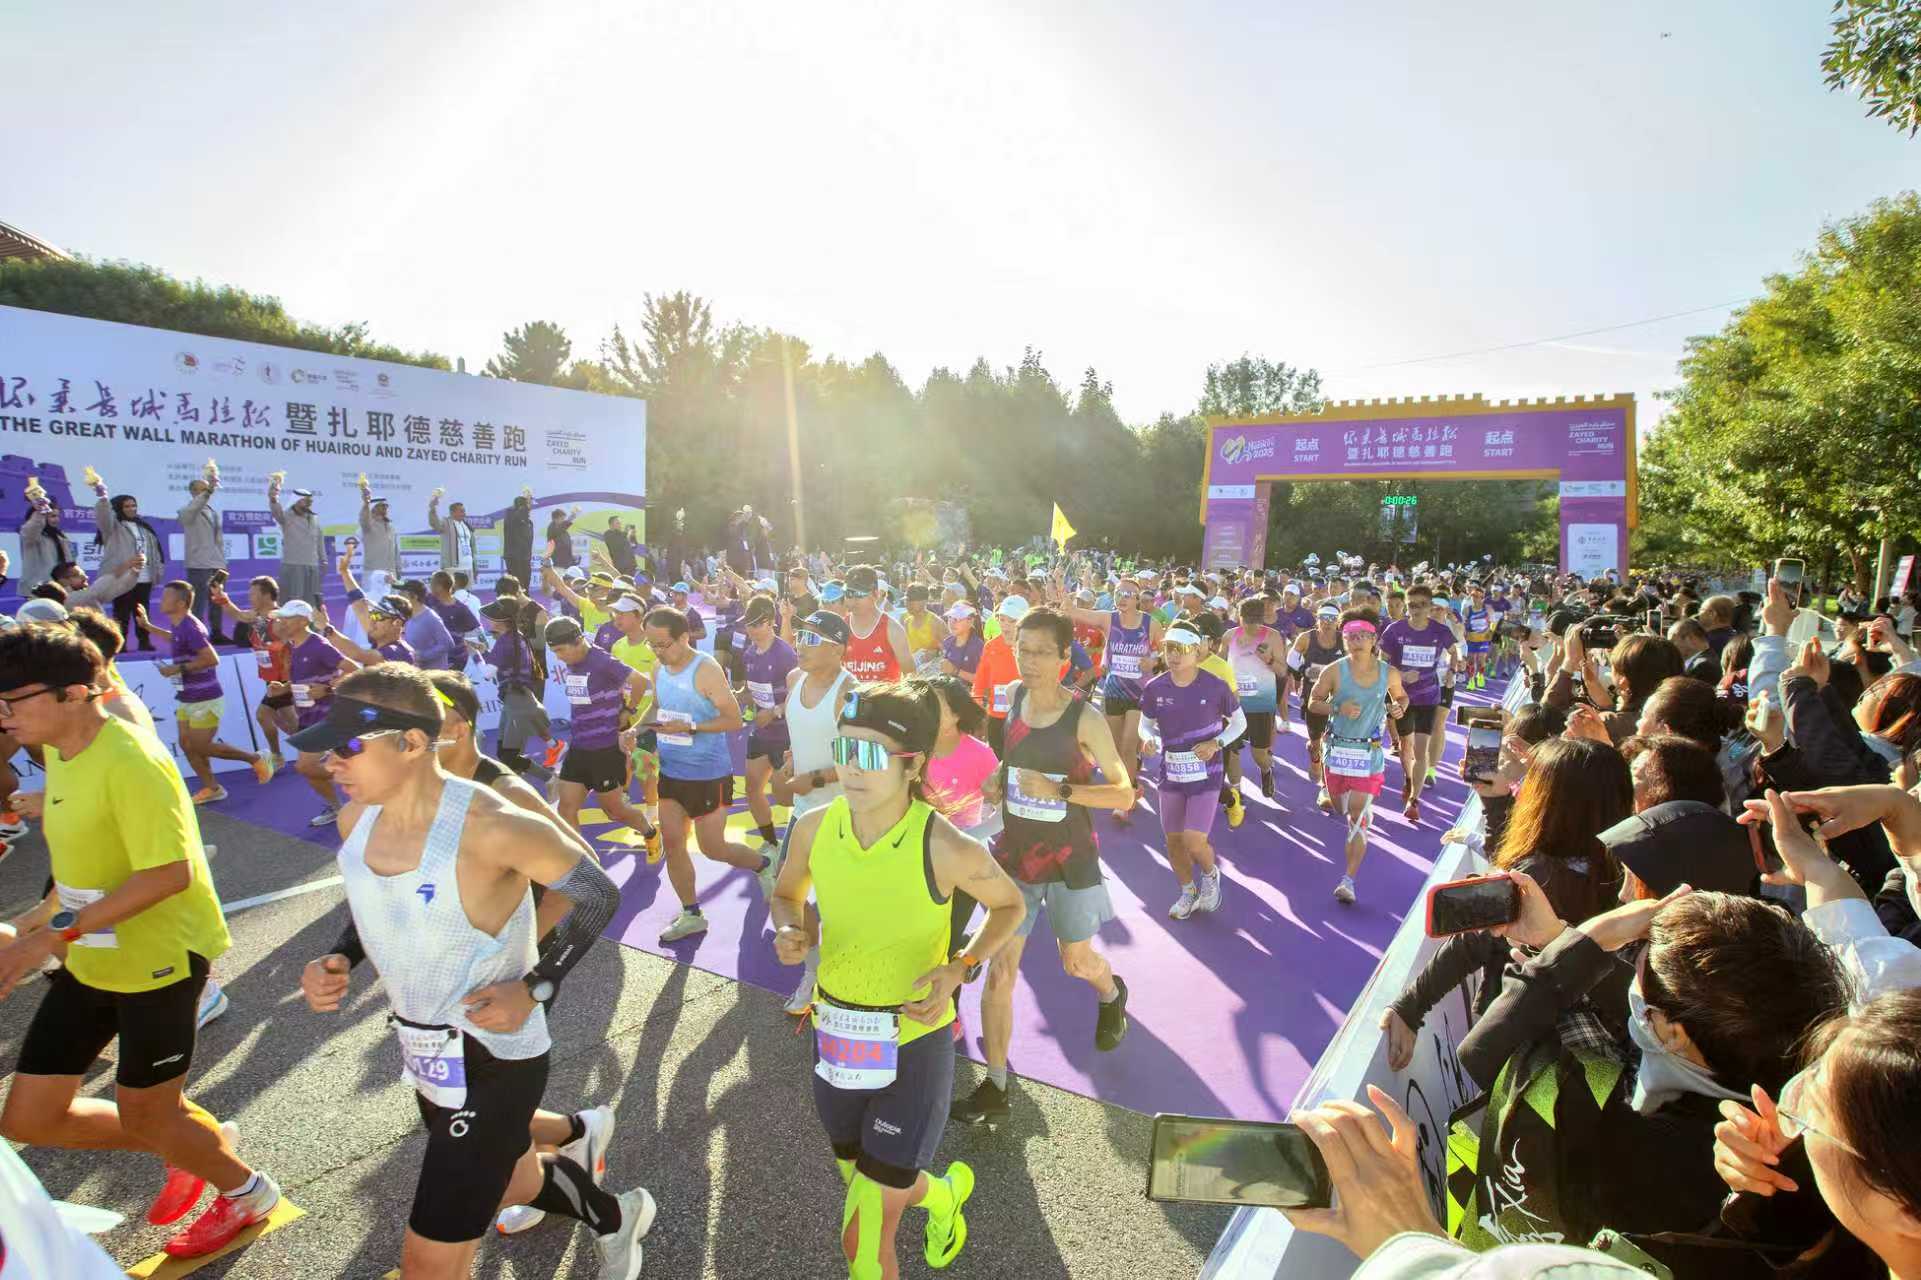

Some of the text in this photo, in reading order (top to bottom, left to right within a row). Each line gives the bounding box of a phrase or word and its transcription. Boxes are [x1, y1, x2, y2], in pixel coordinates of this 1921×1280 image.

[285, 402, 526, 452] 暨扎耶德慈善跑
[0, 415, 527, 467] THE GREAT WALL MARATHON OF HUAIROU AND ZAYED CHARITY RUN
[1295, 438, 1319, 451] 起点
[1484, 430, 1514, 445] 起点
[1294, 454, 1319, 463] START
[1484, 447, 1513, 457] START
